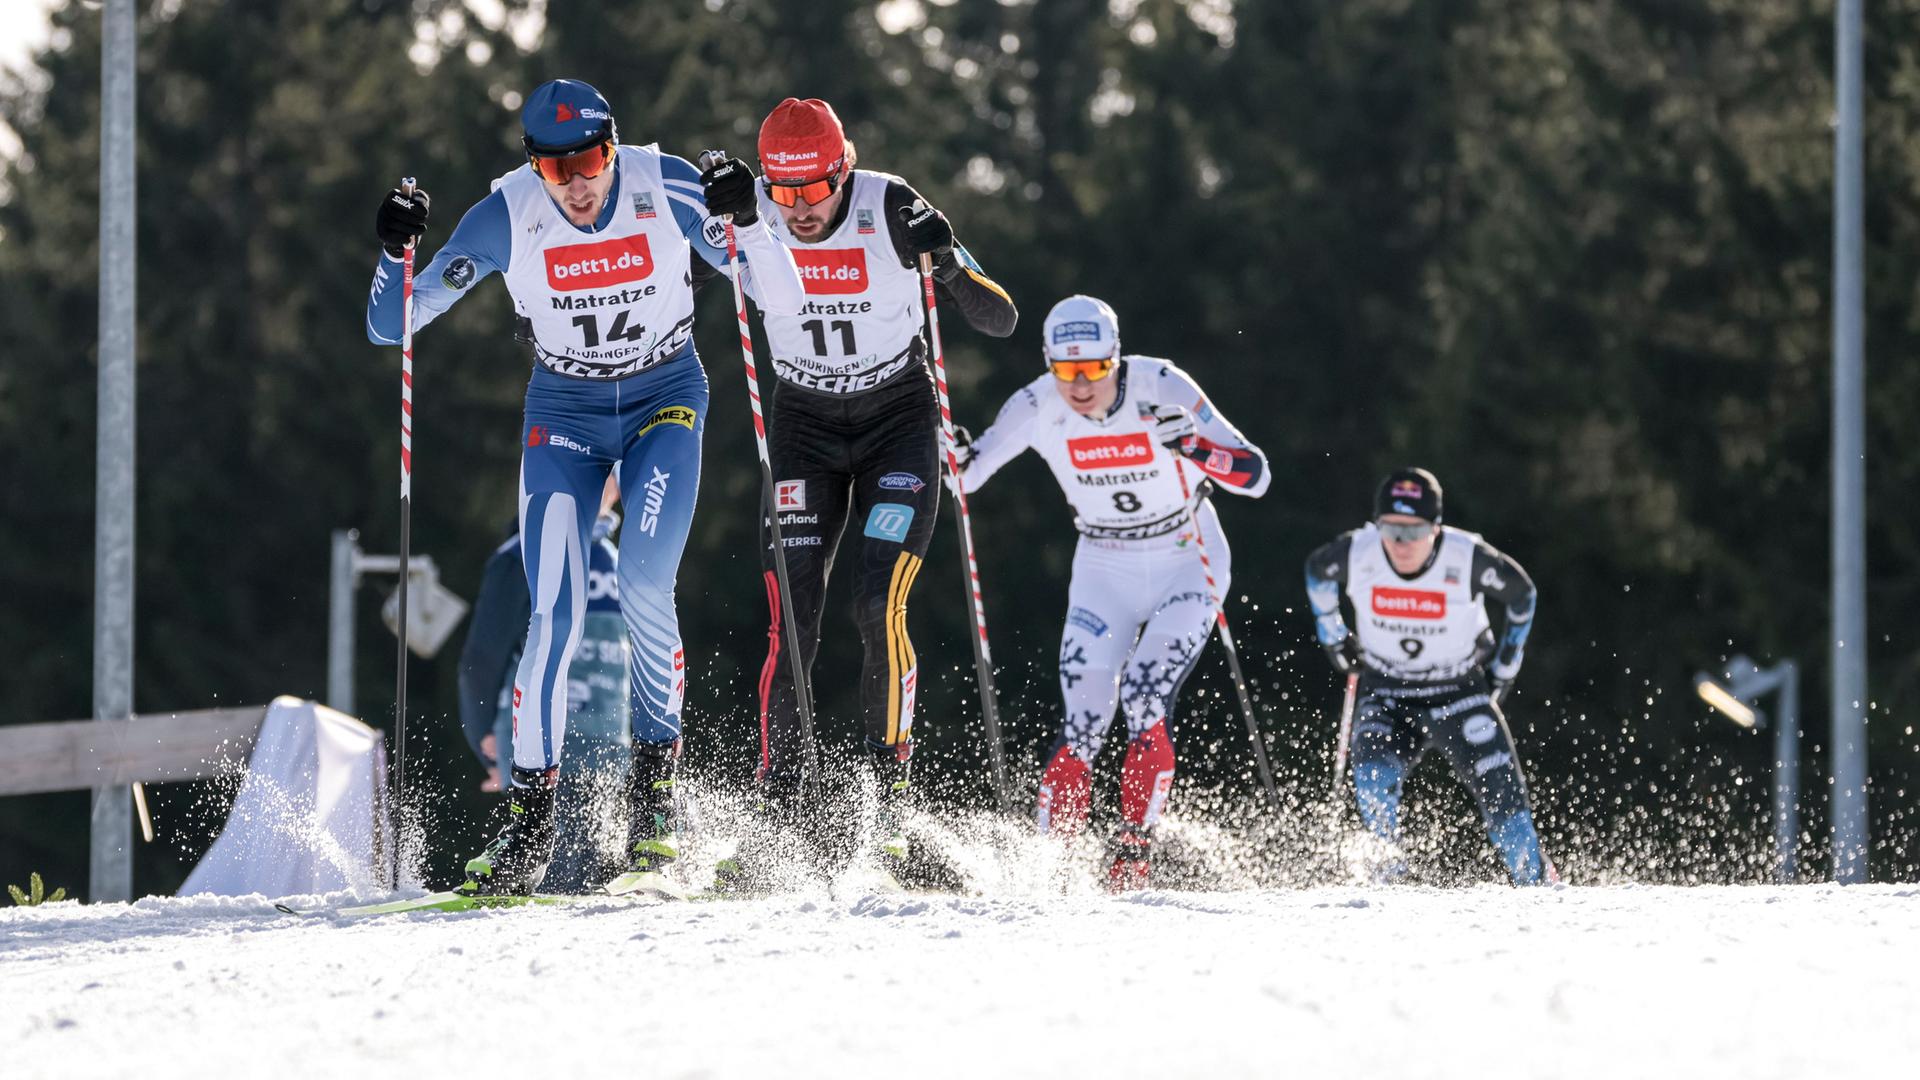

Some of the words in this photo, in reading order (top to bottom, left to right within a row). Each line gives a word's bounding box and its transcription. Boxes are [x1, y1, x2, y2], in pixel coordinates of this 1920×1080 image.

[553, 251, 644, 279] bett1.de
[799, 265, 860, 281] ett1.de
[551, 285, 656, 310] Matratze
[572, 310, 645, 348] 14
[802, 320, 857, 356] 11
[772, 351, 910, 394] SKECHERS
[549, 435, 591, 455] Sievi
[1074, 444, 1147, 462] bett1.de
[1076, 469, 1159, 486] Matratze
[1112, 491, 1142, 513] 8
[765, 514, 817, 527] Kufland
[1400, 639, 1423, 659] 9
